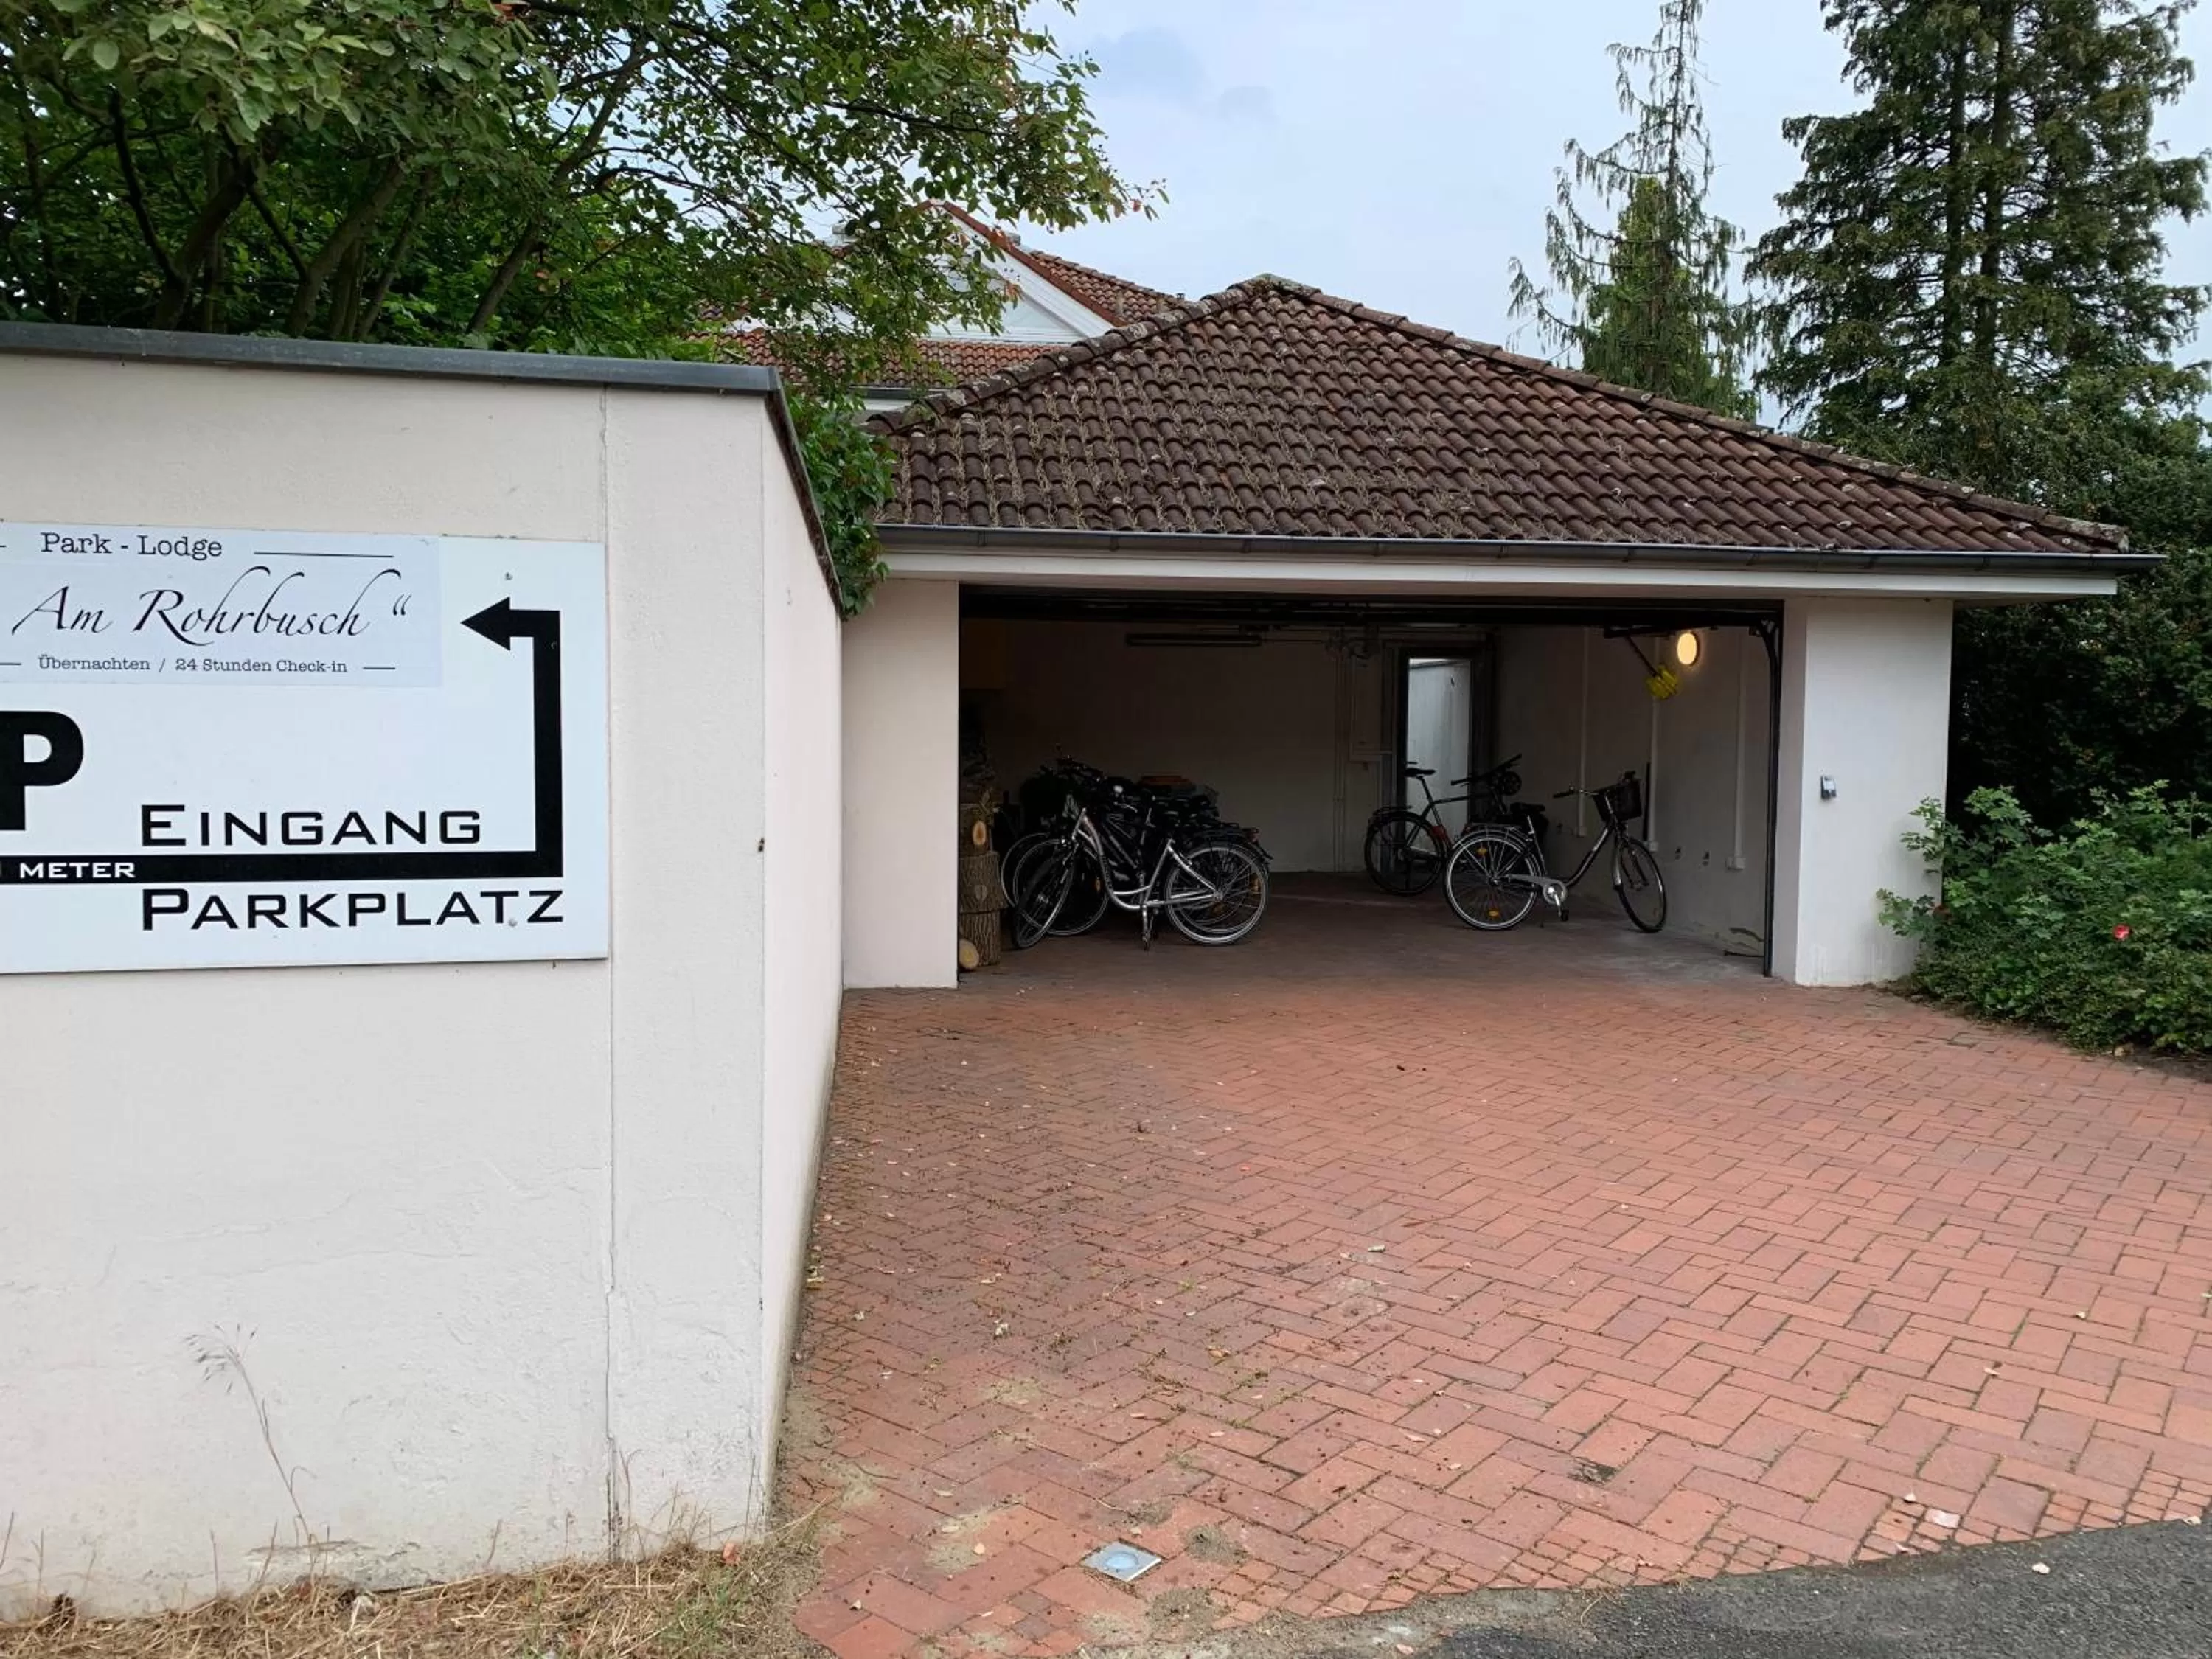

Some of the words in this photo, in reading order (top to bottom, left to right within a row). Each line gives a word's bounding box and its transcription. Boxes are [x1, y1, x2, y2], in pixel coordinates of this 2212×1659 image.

[40, 532, 113, 554] Park
[136, 535, 223, 561] Lodge
[11, 585, 113, 636] Am
[38, 654, 151, 670] Übernachten
[175, 658, 197, 671] 24
[203, 658, 272, 672] Stunden
[276, 659, 347, 673] Check-in
[0, 710, 84, 832] P
[142, 804, 481, 847] EINGANG
[20, 862, 136, 879] METER
[142, 888, 563, 931] PARKPLATZ
